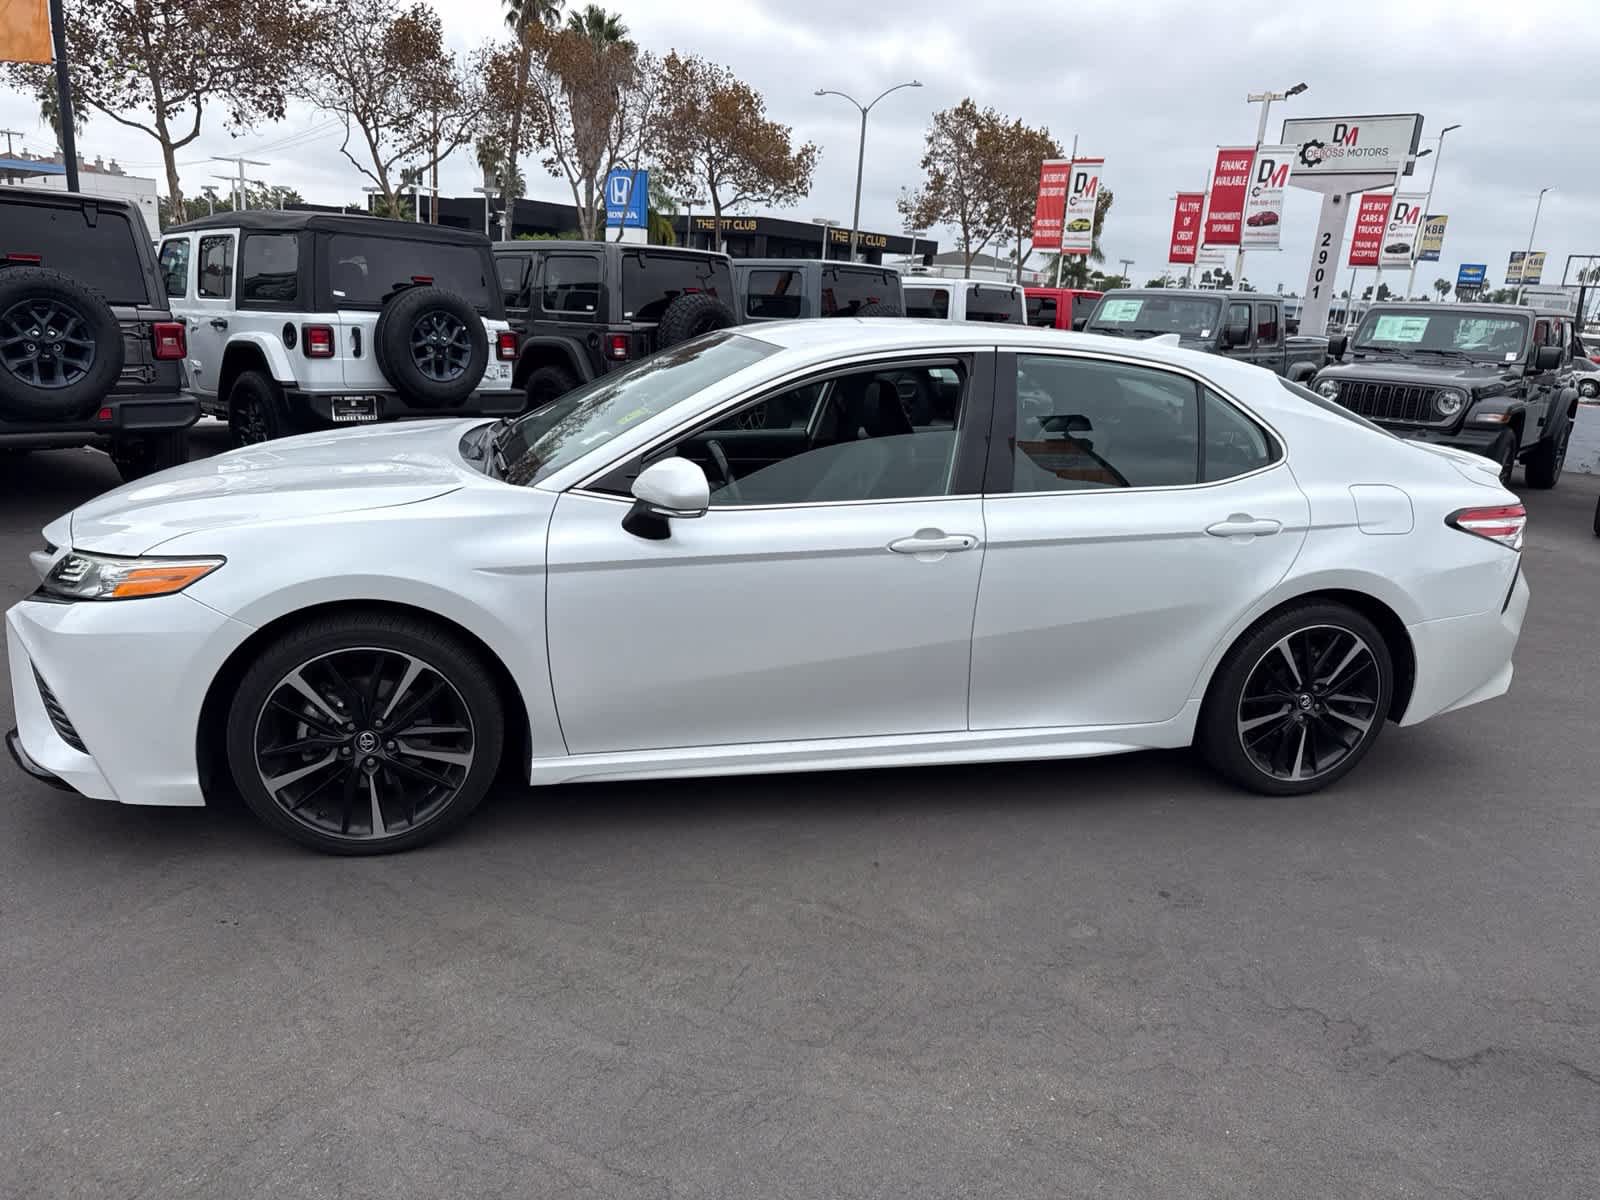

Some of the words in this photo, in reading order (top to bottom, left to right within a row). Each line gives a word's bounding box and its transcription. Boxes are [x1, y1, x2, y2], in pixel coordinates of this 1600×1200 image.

[1347, 148, 1388, 157] MOTORS
[1220, 160, 1248, 171] FINANCE
[1214, 176, 1248, 187] AVAILABLE
[1362, 202, 1374, 211] WE
[1374, 202, 1388, 211] BUY
[1360, 213, 1378, 222] CARS
[1378, 213, 1384, 222] &
[696, 219, 715, 230] THE
[733, 220, 757, 231] CLUB
[1358, 225, 1383, 234] TRUCKS
[830, 229, 849, 243] THE
[865, 234, 887, 248] CLUB
[1312, 232, 1332, 299] 2901
